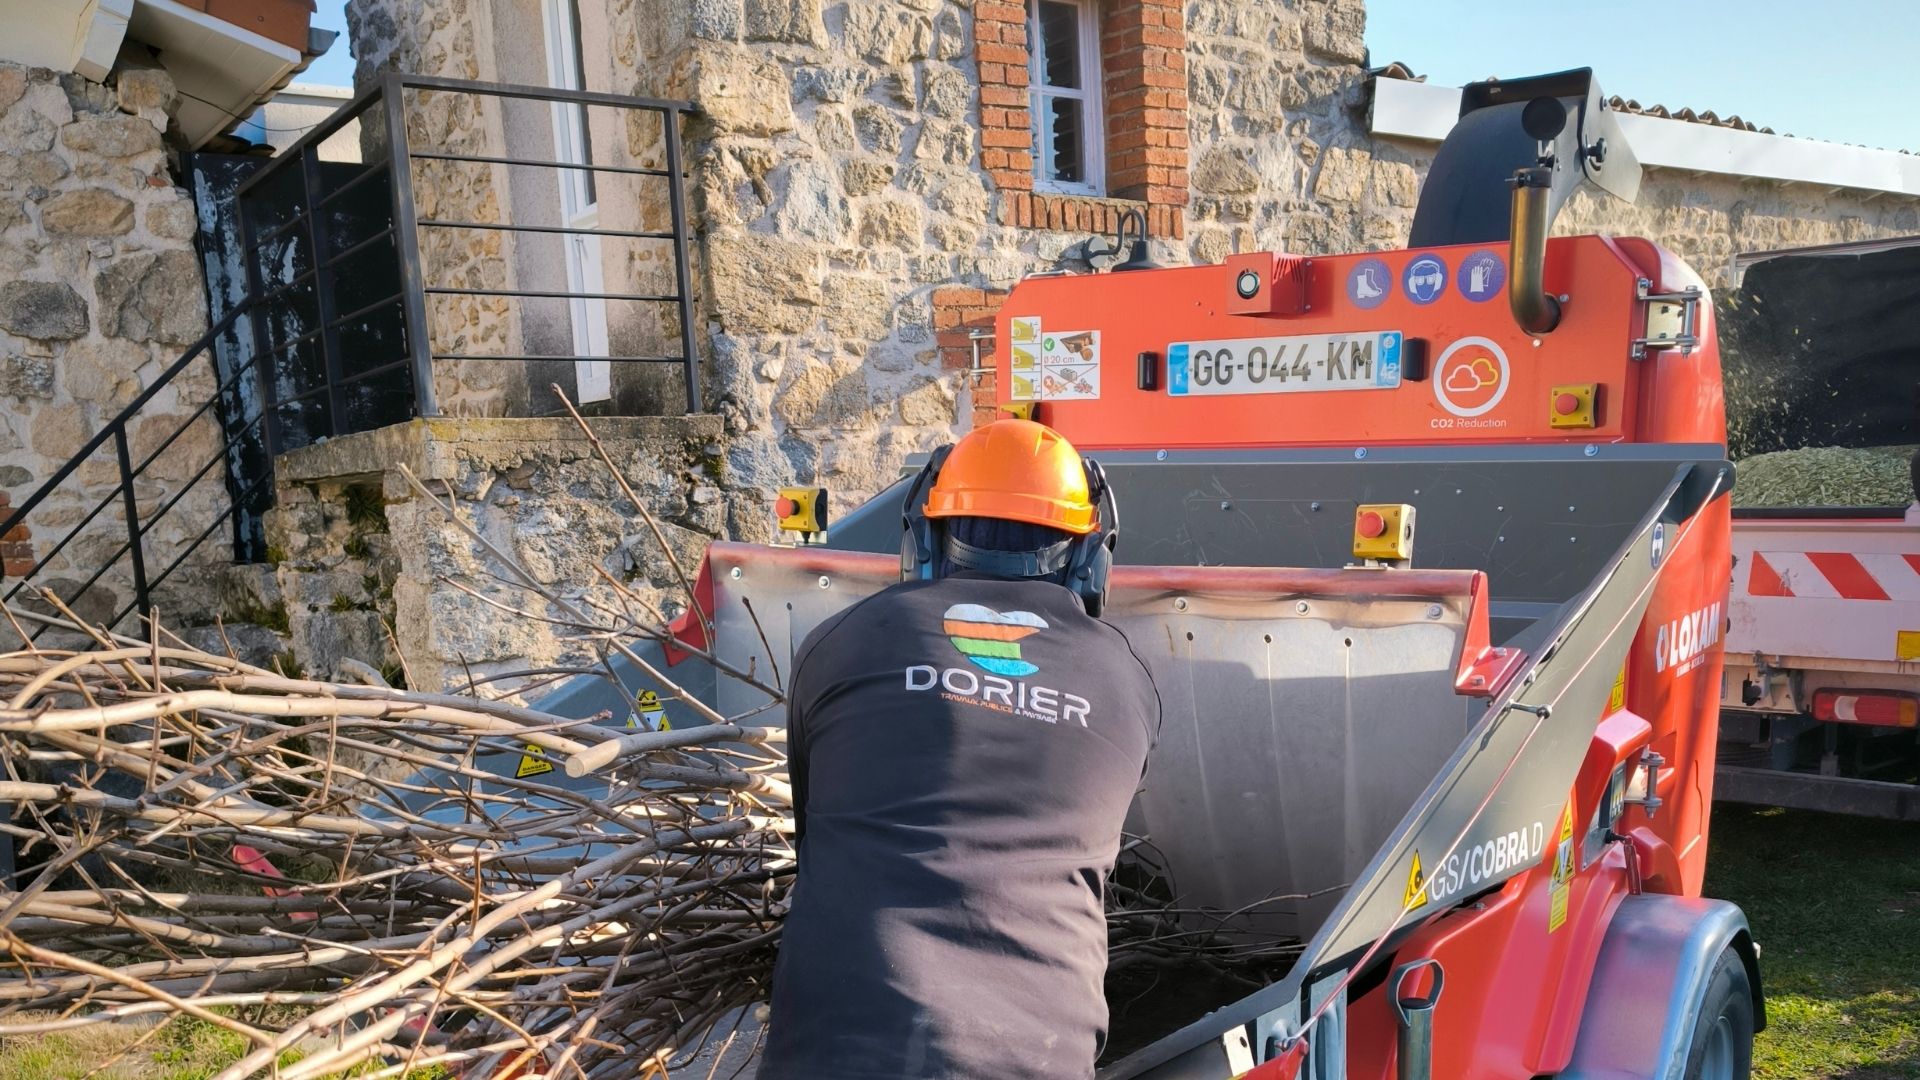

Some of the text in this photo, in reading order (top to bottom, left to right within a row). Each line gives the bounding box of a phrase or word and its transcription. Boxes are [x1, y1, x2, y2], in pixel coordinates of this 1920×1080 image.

[1193, 340, 1373, 386] GG-044-KM
[1379, 363, 1397, 380] 42
[1430, 418, 1507, 429] CO2 Reduction
[1669, 601, 1720, 667] LOXAM
[905, 665, 1091, 728] DORIER
[941, 693, 979, 705] TRAVAUX
[980, 700, 1013, 714] PUBLICS
[1532, 822, 1543, 858] D
